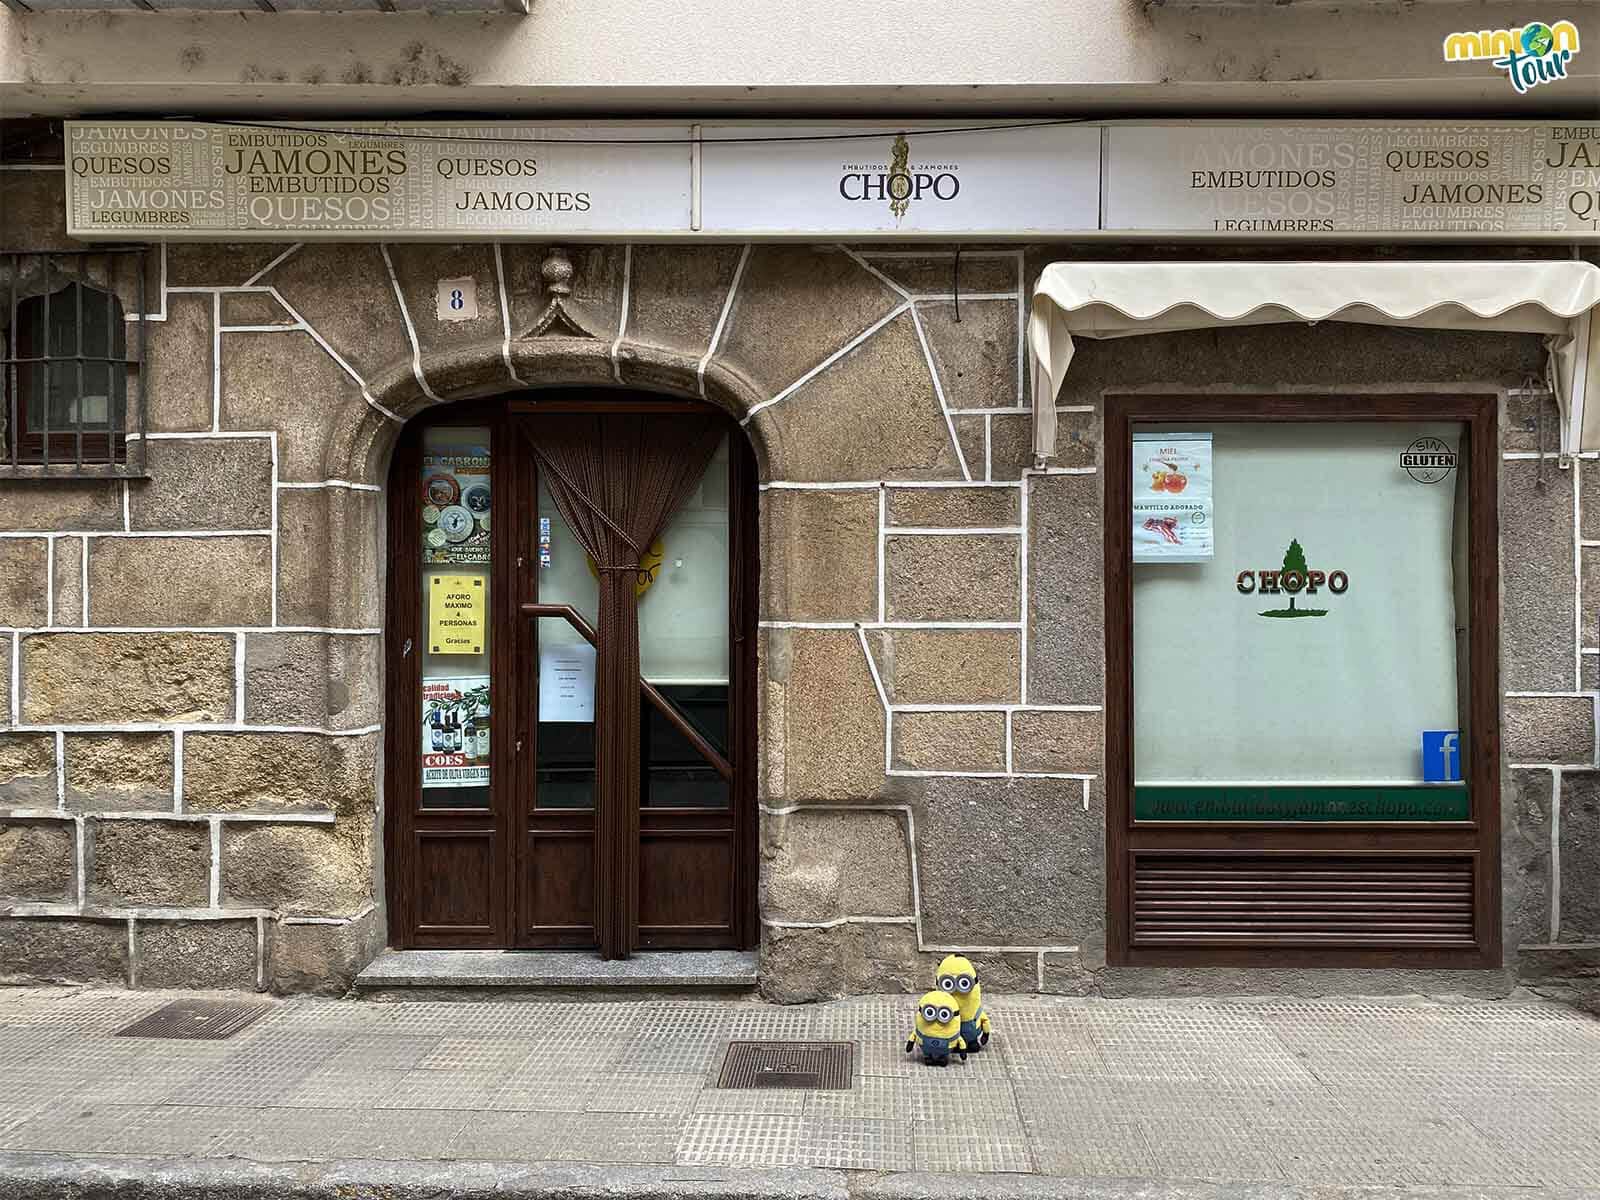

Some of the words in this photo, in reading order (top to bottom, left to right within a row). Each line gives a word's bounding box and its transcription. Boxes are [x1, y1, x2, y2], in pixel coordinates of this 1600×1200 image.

[72, 142, 170, 154] LEGUMBRES
[228, 134, 328, 147] EMBUTIDOS
[71, 156, 171, 177] QUESOS
[225, 149, 407, 175] JAMONES
[437, 158, 537, 179] QUESOS
[1385, 150, 1490, 172] QUESOS
[250, 176, 391, 194] EMBUTIDOS
[840, 172, 960, 201] CHOPO
[1192, 170, 1336, 188] EMBUTIDOS
[91, 189, 225, 209] JAMONES
[455, 191, 591, 212] JAMONES
[1403, 184, 1543, 204] JAMONES
[91, 210, 190, 224] LEGUMBRES
[249, 196, 391, 225] QUESOS
[1213, 219, 1335, 231] LEGUMBRES
[451, 289, 463, 310] 8
[1416, 440, 1441, 451] SIN
[1403, 455, 1454, 466] GLUTEN
[1236, 570, 1349, 594] CHOPO
[423, 683, 449, 692] calidad
[425, 755, 464, 766] COES
